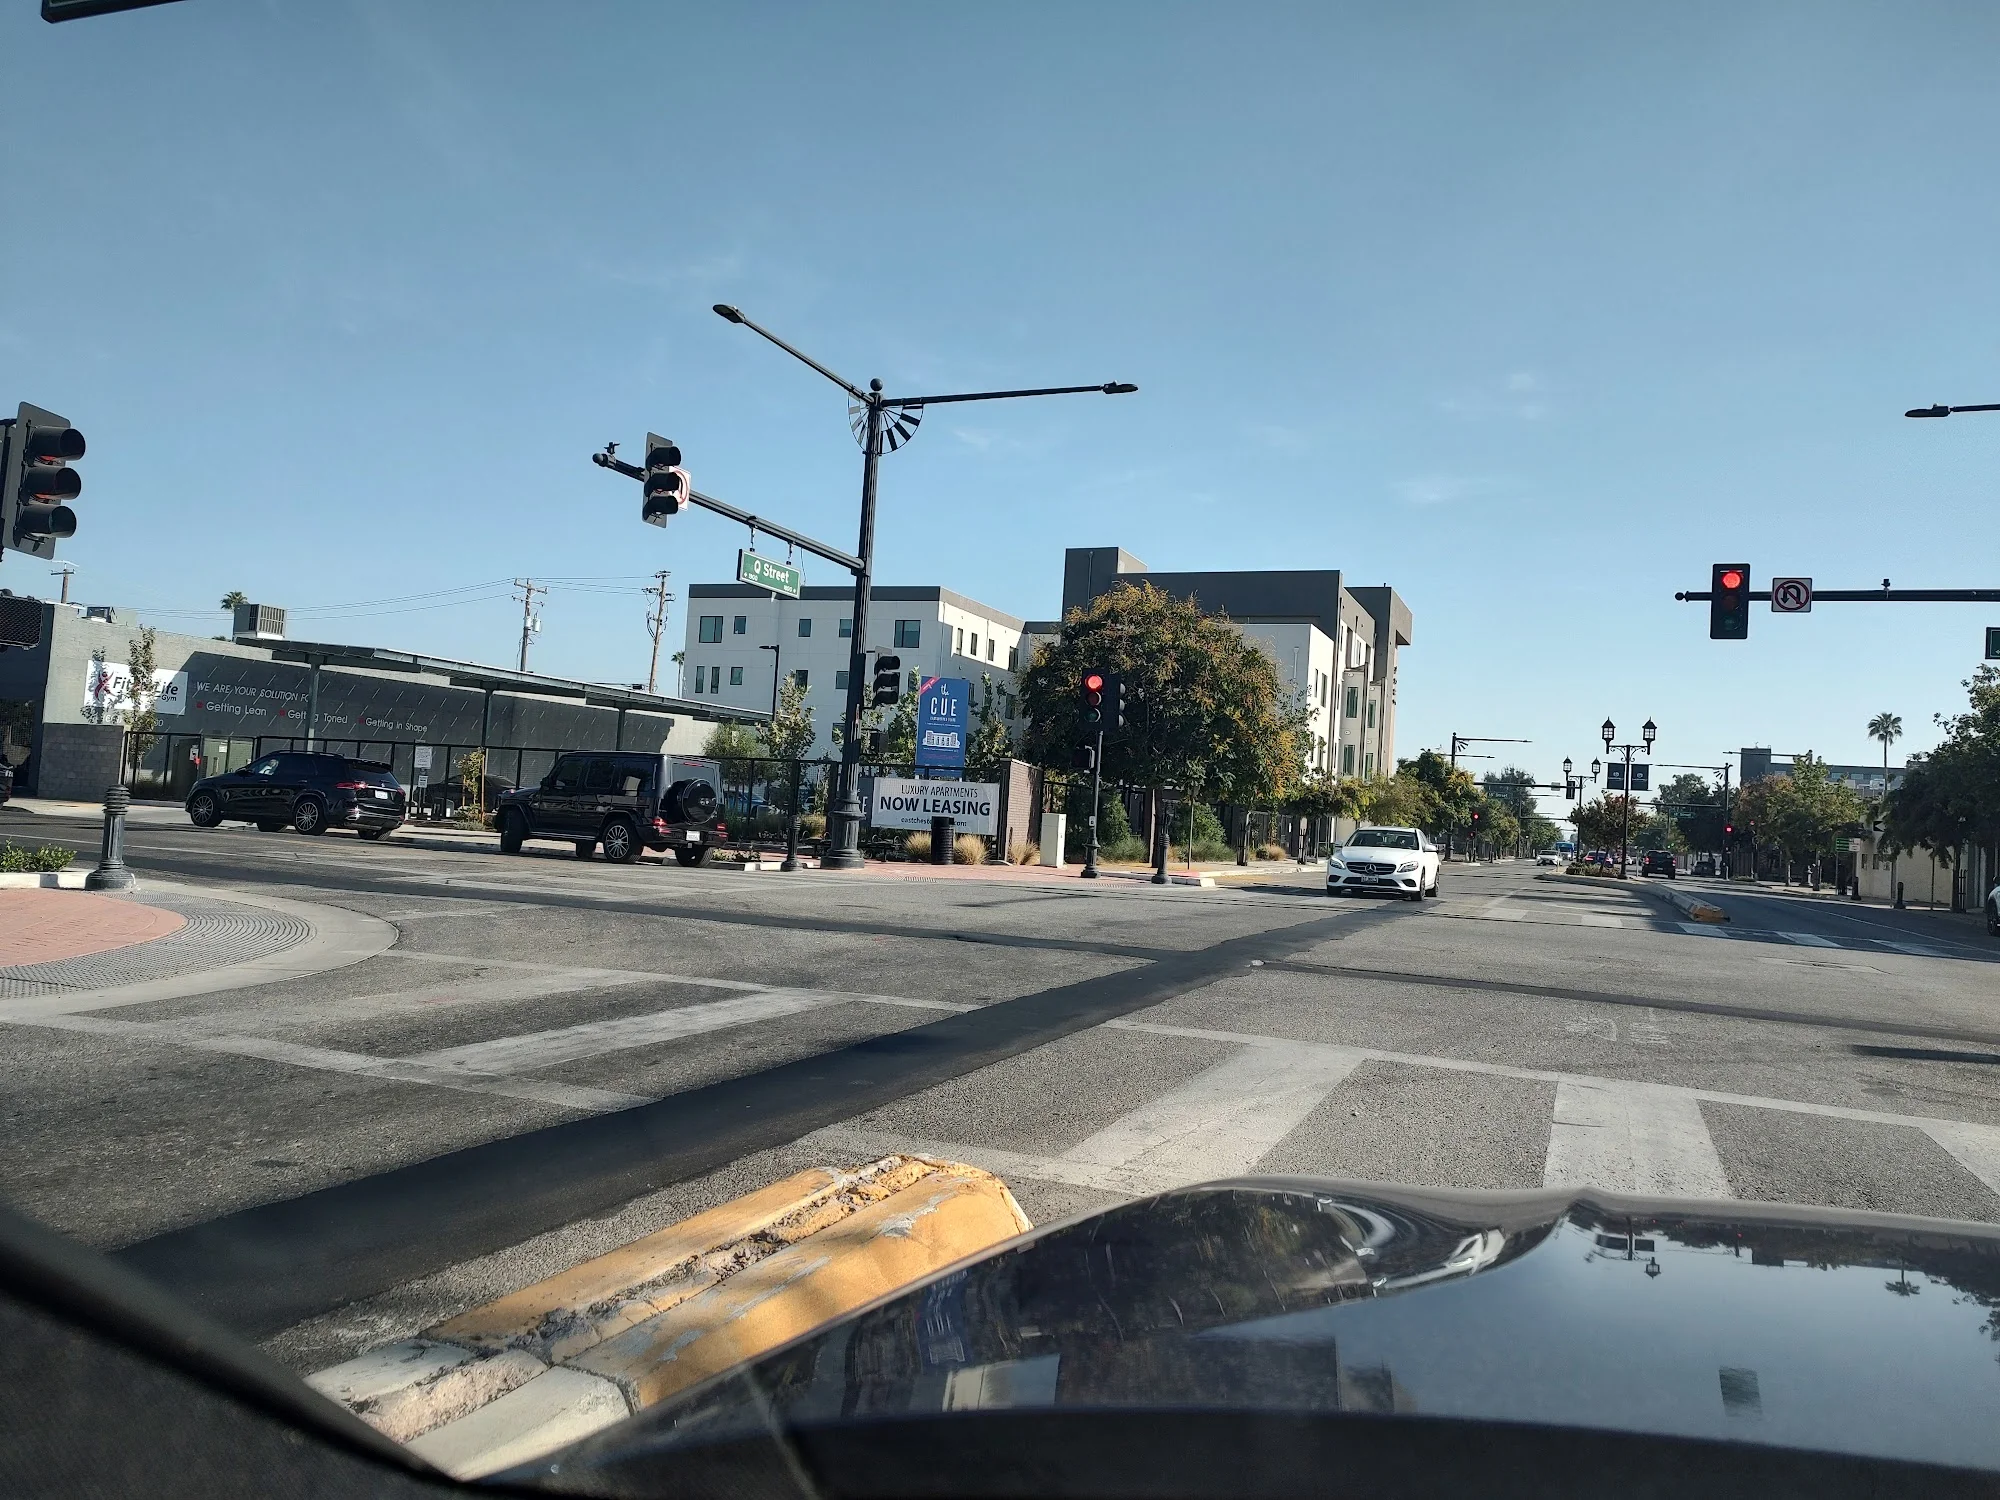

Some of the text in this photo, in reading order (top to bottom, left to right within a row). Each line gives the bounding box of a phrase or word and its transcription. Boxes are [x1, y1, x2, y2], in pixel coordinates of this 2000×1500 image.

[754, 560, 789, 583] Q Street
[113, 676, 131, 690] Fit
[161, 694, 177, 702] Gym
[196, 681, 210, 691] WE
[212, 683, 231, 694] ARE
[234, 686, 257, 696] YOUR
[259, 689, 298, 701] SOLUTION
[206, 702, 267, 716] Getting Lean
[930, 697, 957, 716] CUE
[287, 710, 347, 724] Gettg Toned
[366, 718, 393, 730] Getting
[406, 723, 427, 732] Shape
[901, 784, 978, 798] LUXURY APARTMENTS
[880, 797, 919, 811] NOW
[922, 799, 990, 816] LEASING
